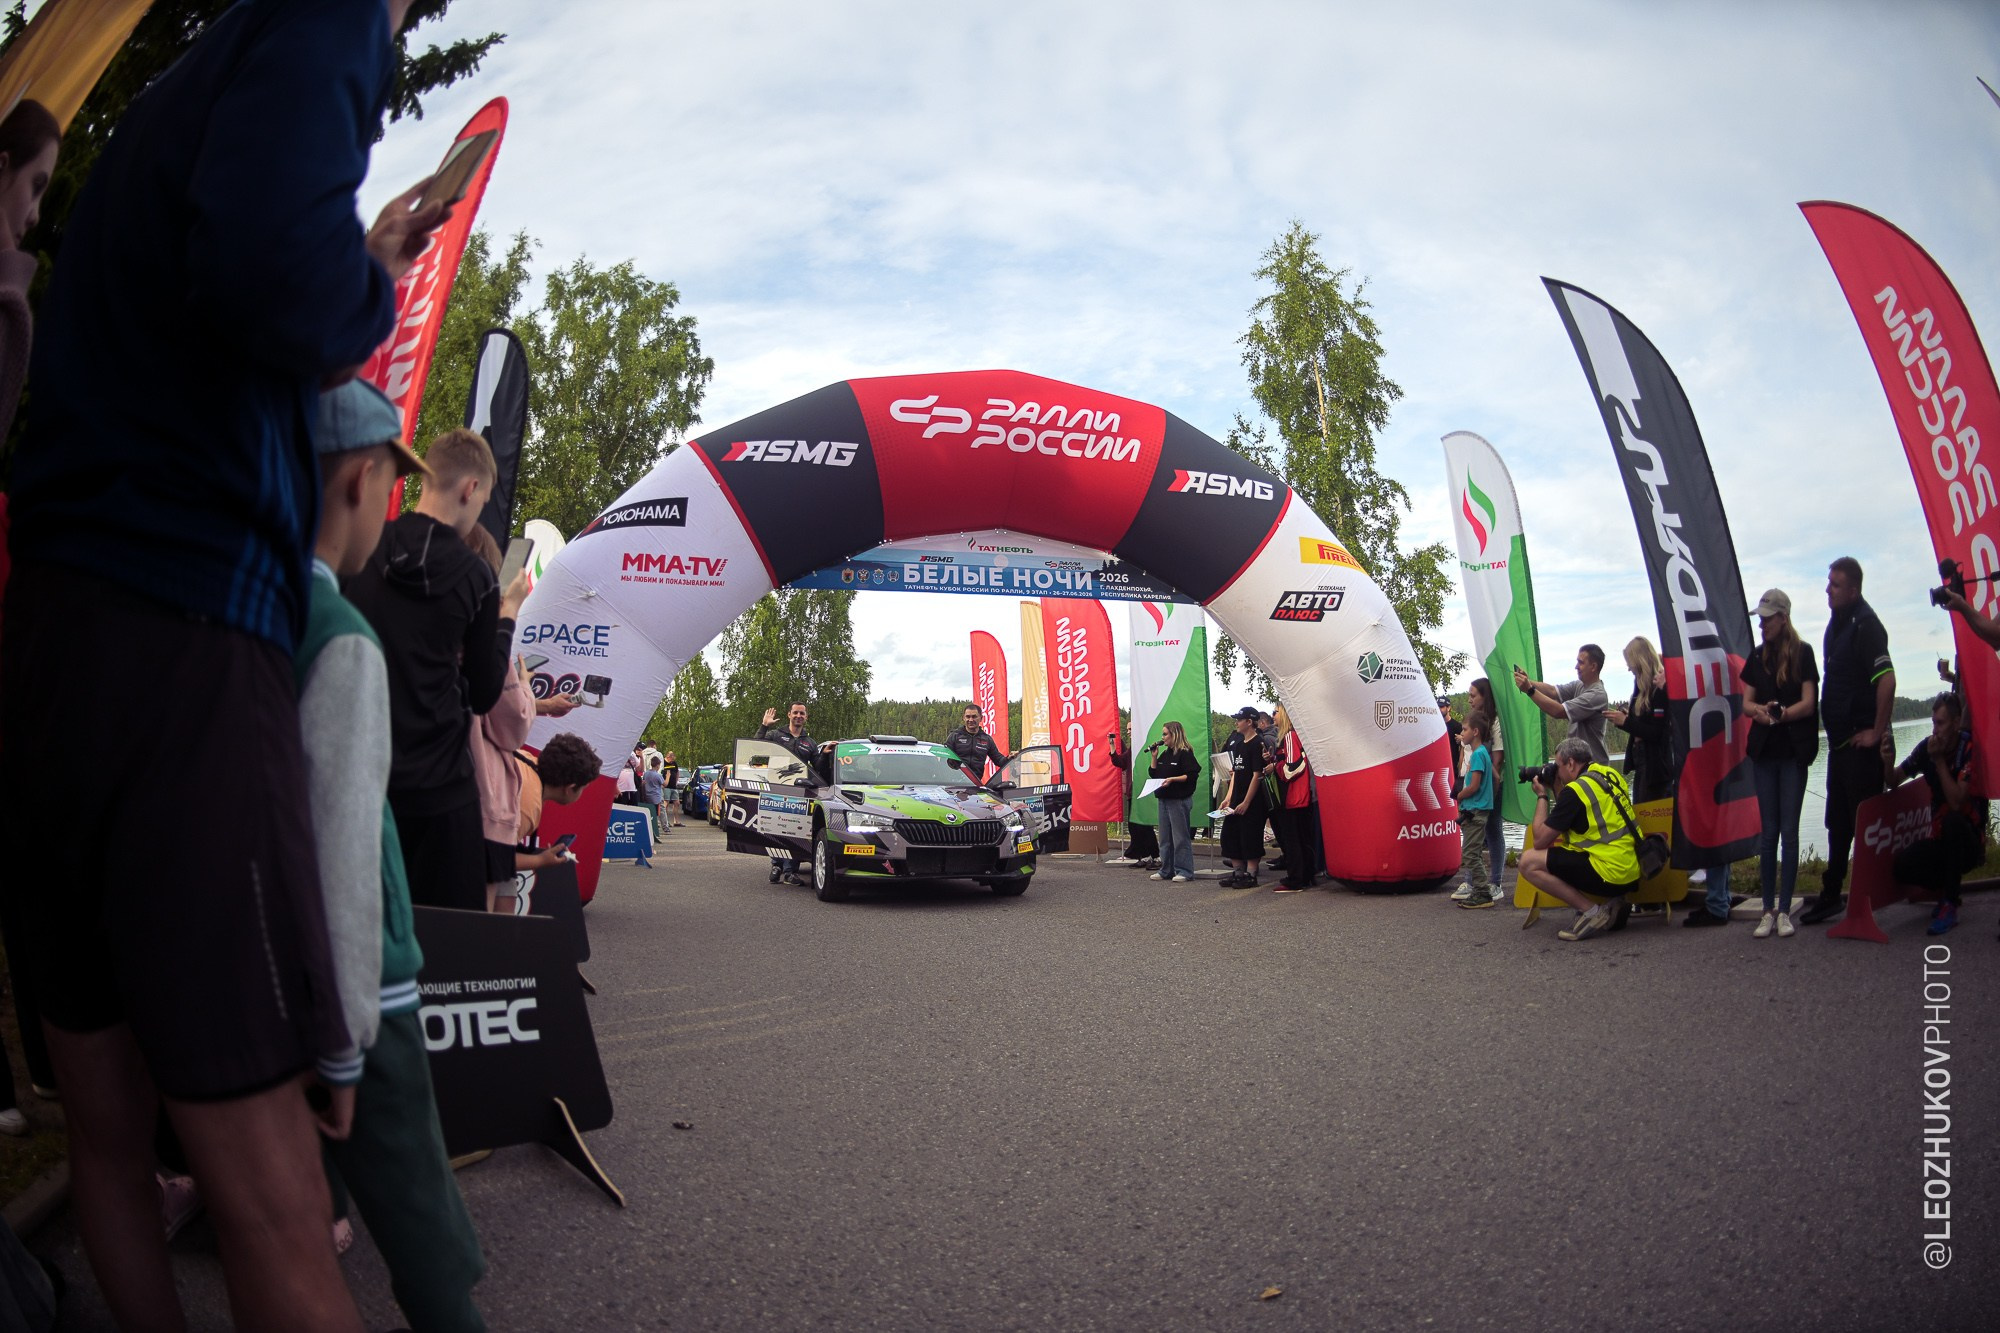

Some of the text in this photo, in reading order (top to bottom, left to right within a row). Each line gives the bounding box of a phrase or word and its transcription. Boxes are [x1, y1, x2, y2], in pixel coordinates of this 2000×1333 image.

[981, 398, 1121, 433] РАЛЛИ
[970, 423, 1141, 463] РОССИИ
[736, 439, 859, 467] ASMG
[1180, 470, 1274, 501] ASMG
[602, 504, 680, 526] YOKOHAMA
[977, 545, 1033, 554] ТАТНЕФТЬ
[923, 555, 955, 563] ASMG
[634, 575, 658, 584] ЛЮБИМ
[666, 578, 708, 587] ПОКАЗЫВАЕМ
[903, 563, 1093, 590] БЕЛЫЕ НОЧИ
[1099, 572, 1129, 583] 2026
[1100, 591, 1142, 599] РЕСПУБЛИКА
[1278, 593, 1340, 609] АВТО
[1274, 609, 1321, 620] ПЛЮС
[521, 624, 611, 646] SPACE
[562, 645, 609, 657] TRAVEL
[1397, 715, 1419, 724] РУСЬ
[837, 755, 853, 766] 10
[760, 799, 784, 808] БЕЛЫЕ
[785, 802, 807, 811] НОЧИ
[1396, 820, 1457, 841] ASMG.RU
[606, 836, 636, 844] TRAVEL
[846, 845, 873, 854] PIRELLI
[463, 977, 537, 992] ТЕХНОЛОГИИ
